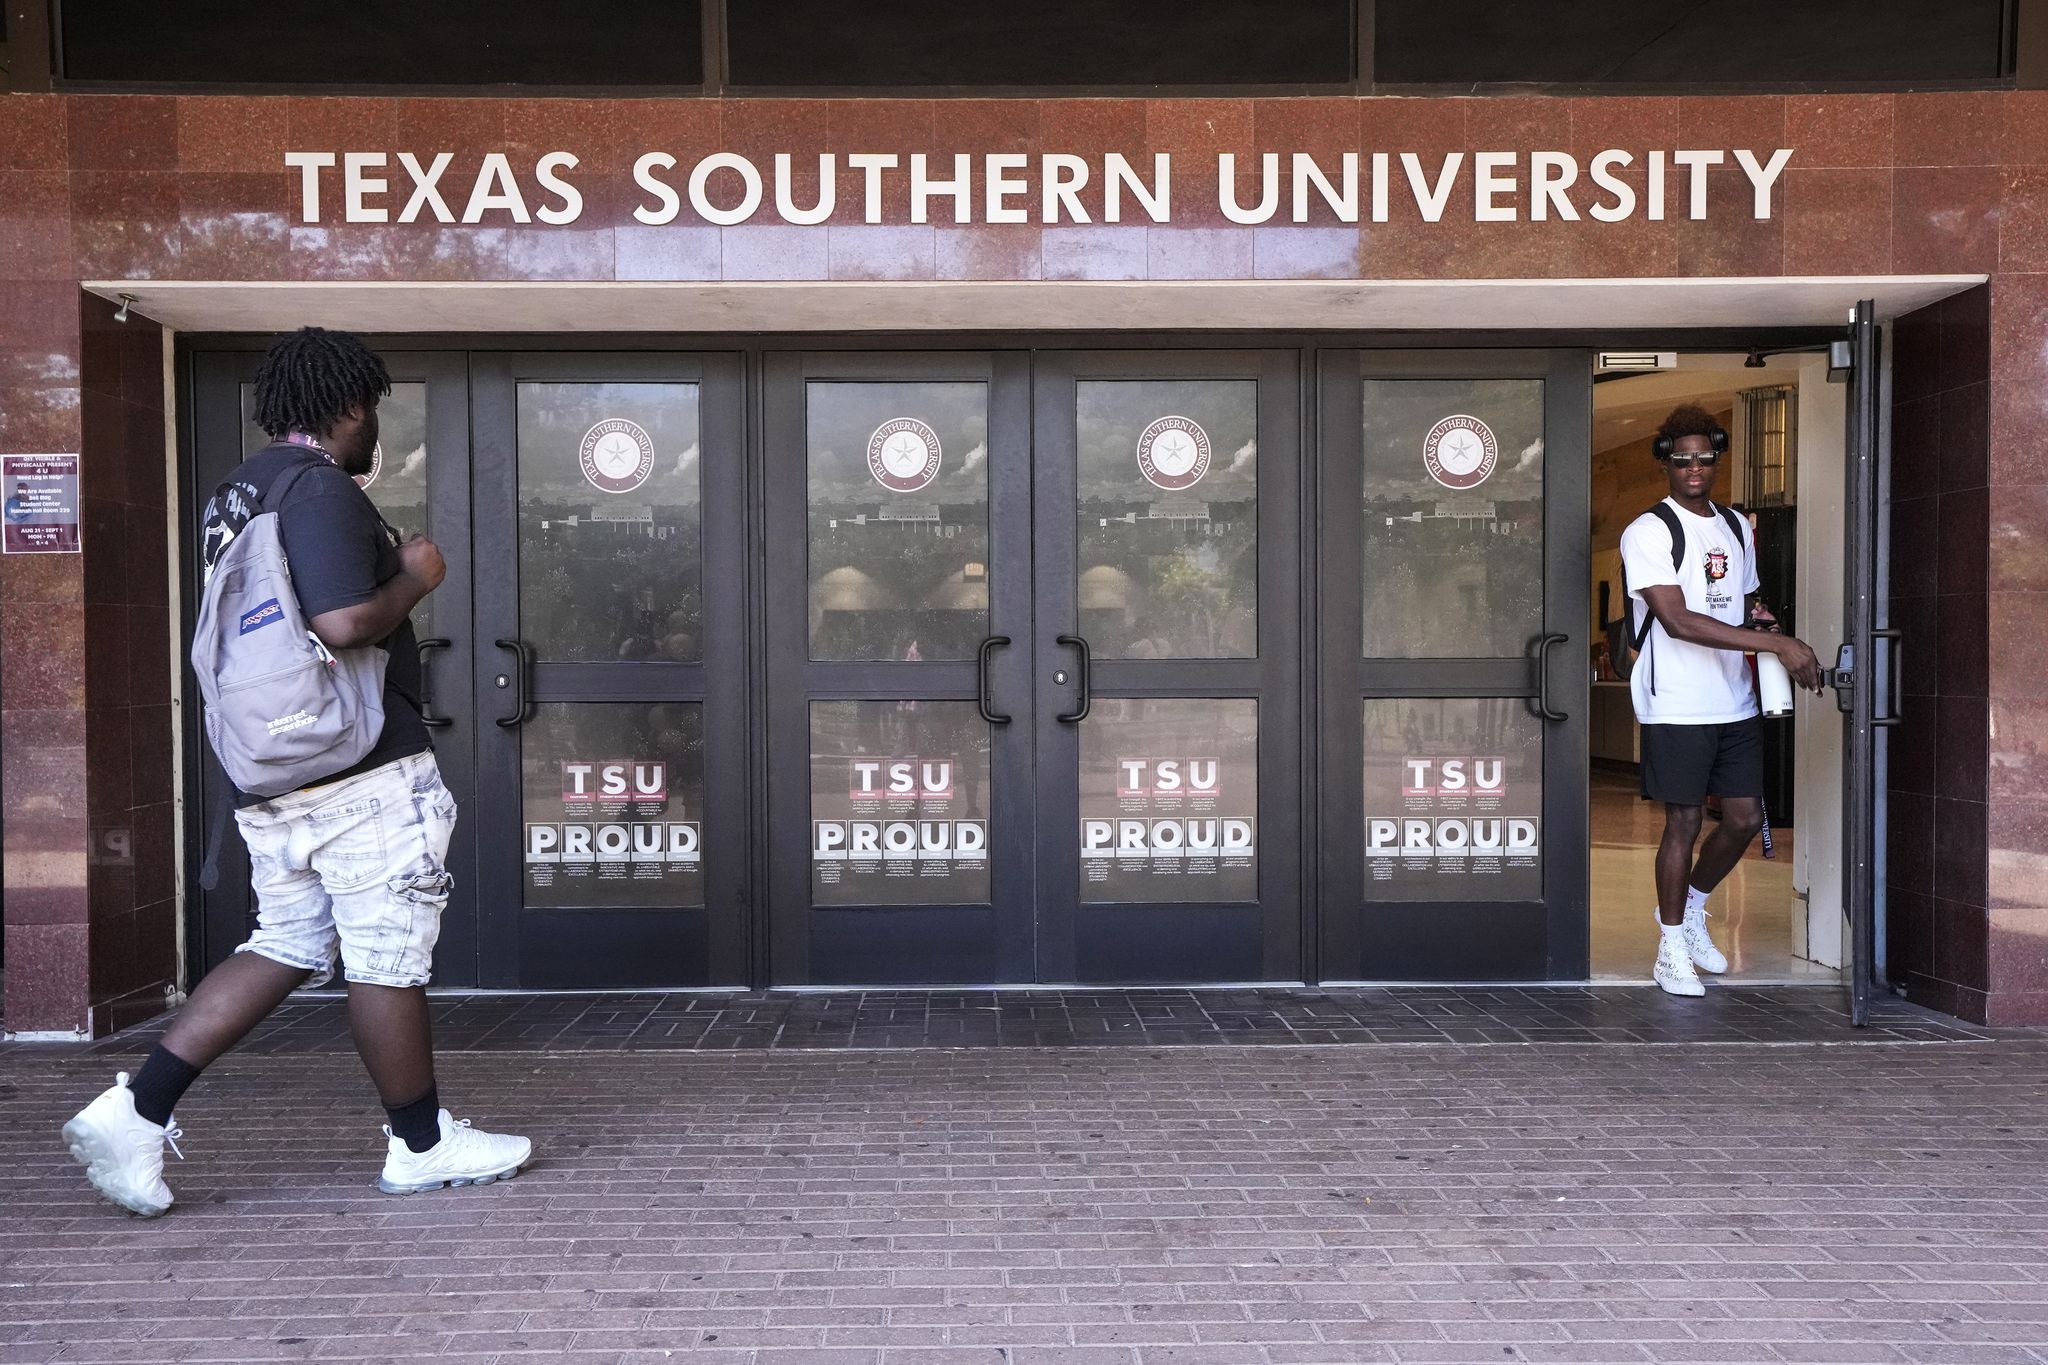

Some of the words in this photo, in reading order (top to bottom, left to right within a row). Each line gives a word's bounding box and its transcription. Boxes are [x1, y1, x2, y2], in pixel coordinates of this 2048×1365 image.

[285, 151, 584, 225] TEXAS
[632, 151, 1171, 225] SOUTHERN
[1217, 148, 1795, 225] UNIVERSITY
[585, 422, 631, 449] SOUTHERN
[873, 422, 919, 448] SOUTHERN
[1143, 420, 1188, 446] SOUTHERN
[1429, 419, 1475, 446] SOUTHERN
[584, 449, 599, 480] TEXAS
[632, 428, 650, 482] UNIVERSITY
[872, 449, 887, 479] TEXAS
[919, 427, 938, 480] UNIVERSITY
[1141, 448, 1156, 477] TEXAS
[1188, 426, 1207, 478] UNIVERSITY
[1428, 447, 1443, 476] TEXAS
[1475, 424, 1494, 477] UNIVERSITY
[267, 710, 307, 728] internet
[269, 715, 318, 736] essentials
[567, 765, 662, 794] TSU
[855, 764, 949, 792] TSU
[1122, 761, 1216, 789] TSU
[1408, 760, 1501, 789] TSU
[531, 825, 697, 854] PROUD
[819, 823, 984, 852] PROUD
[1086, 820, 1251, 850] PROUD
[1371, 820, 1536, 849] PROUD
